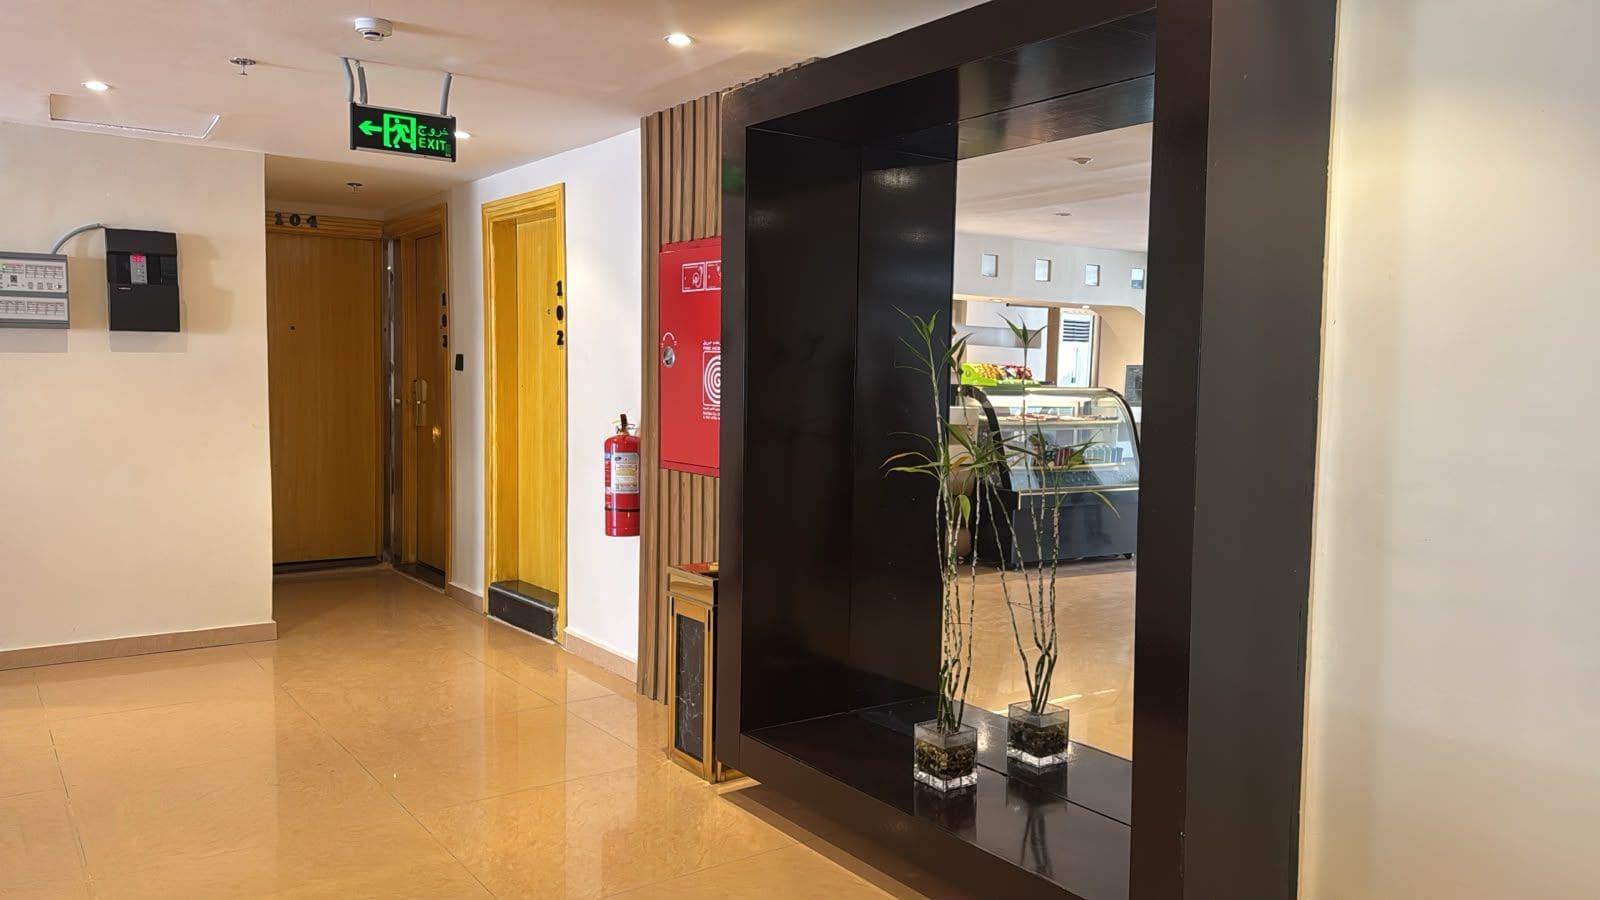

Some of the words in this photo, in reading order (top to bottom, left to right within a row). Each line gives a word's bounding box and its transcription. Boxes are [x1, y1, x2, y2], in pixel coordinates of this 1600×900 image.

[417, 125, 449, 137] خروج
[418, 137, 447, 151] EXIT
[274, 211, 318, 228] 104
[556, 280, 564, 346] 102
